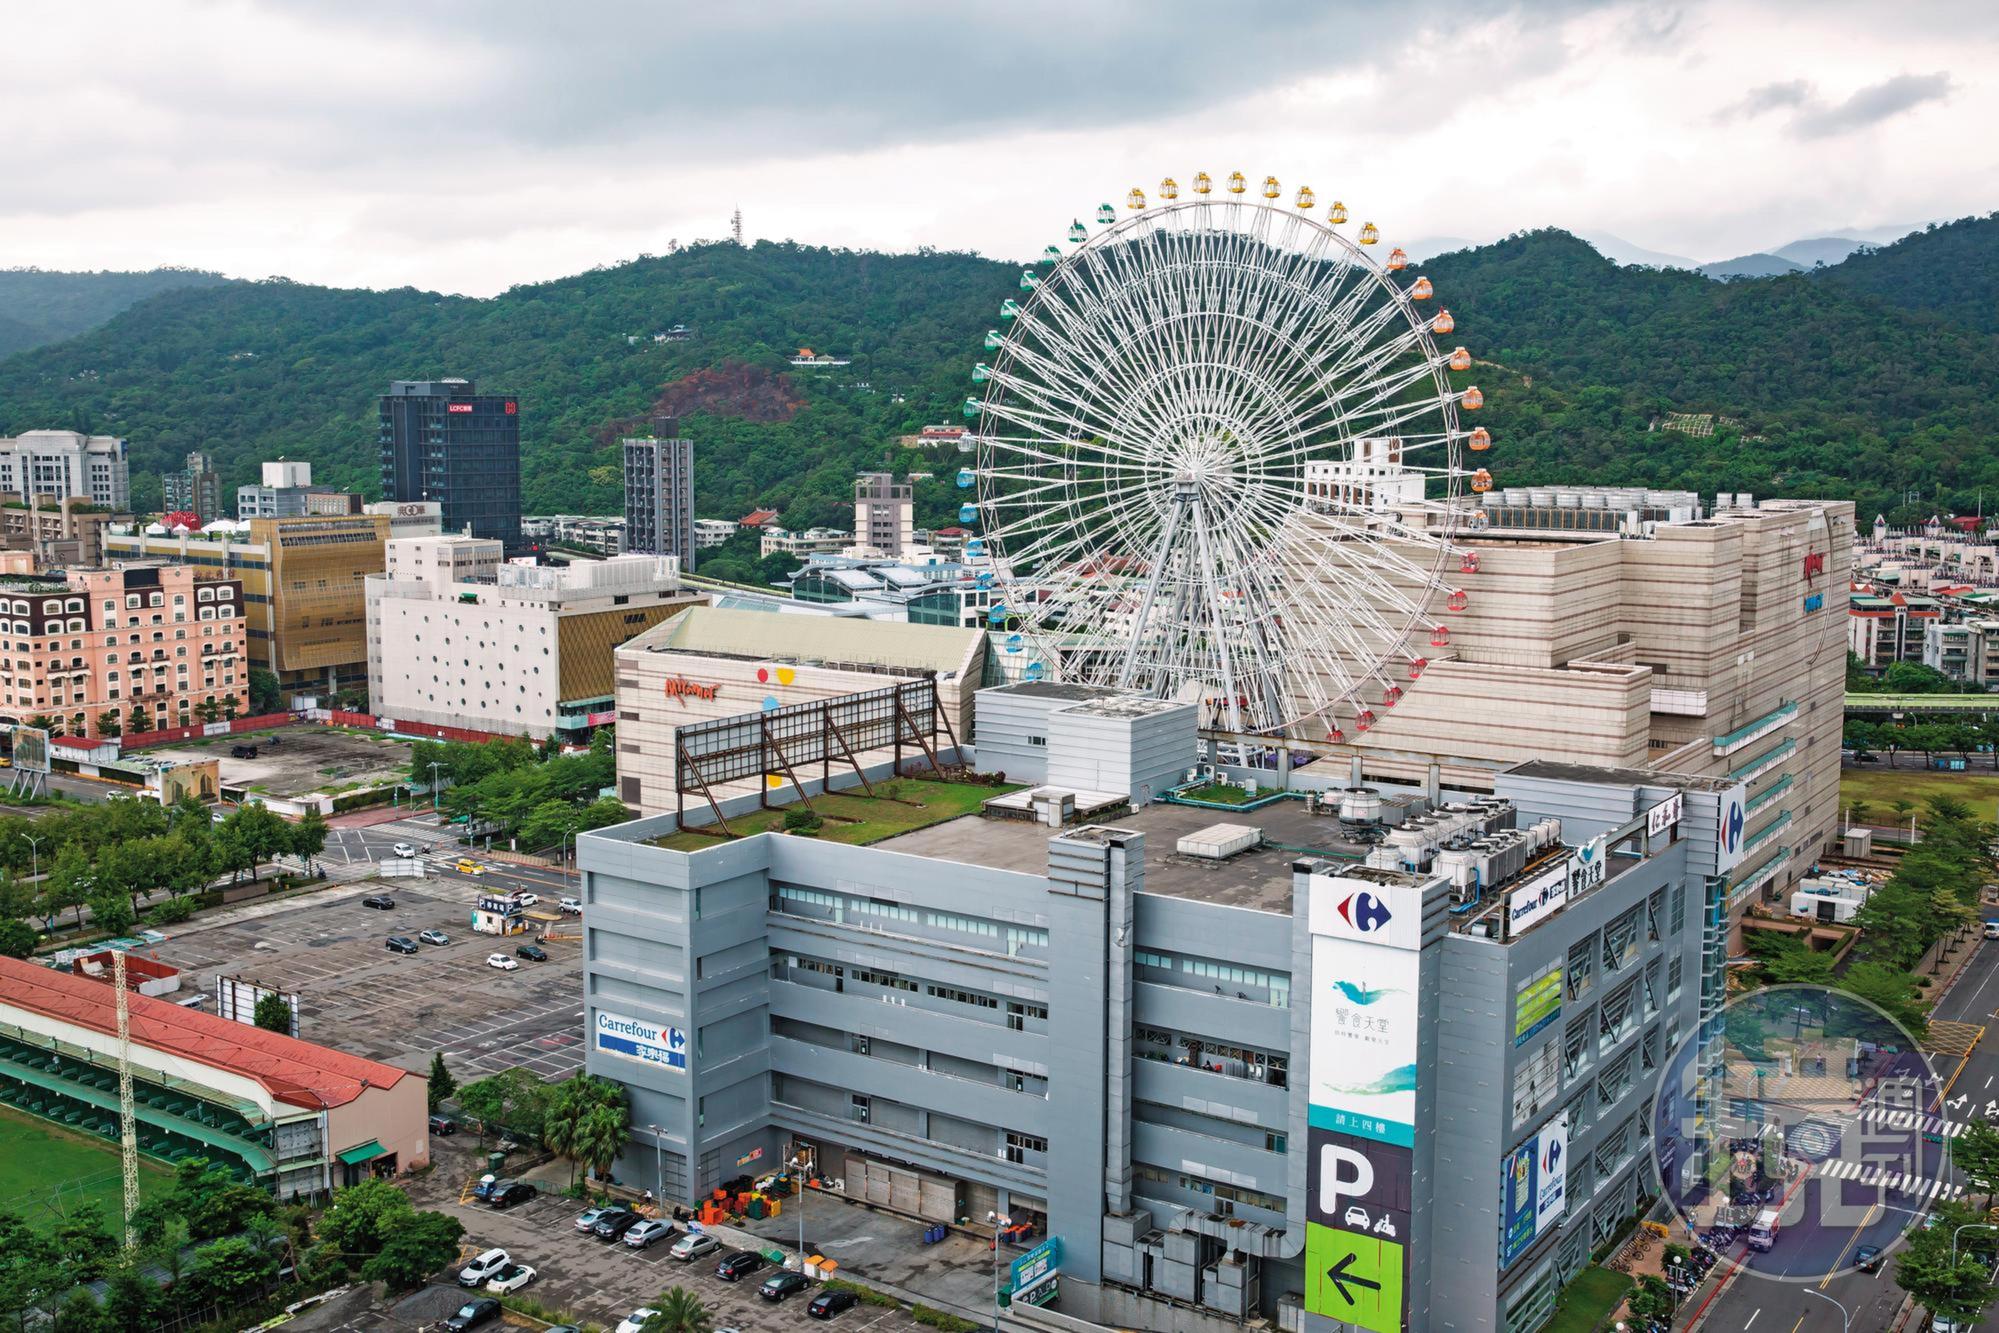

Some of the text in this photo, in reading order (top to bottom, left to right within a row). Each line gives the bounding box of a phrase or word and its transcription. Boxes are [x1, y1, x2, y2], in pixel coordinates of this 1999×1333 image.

[1512, 899, 1538, 921] Carrefour
[599, 1014, 657, 1041] Carrefour
[1335, 1113, 1386, 1134] 請上四樓
[1320, 1143, 1374, 1215] P
[1539, 1173, 1563, 1201] Carrefour
